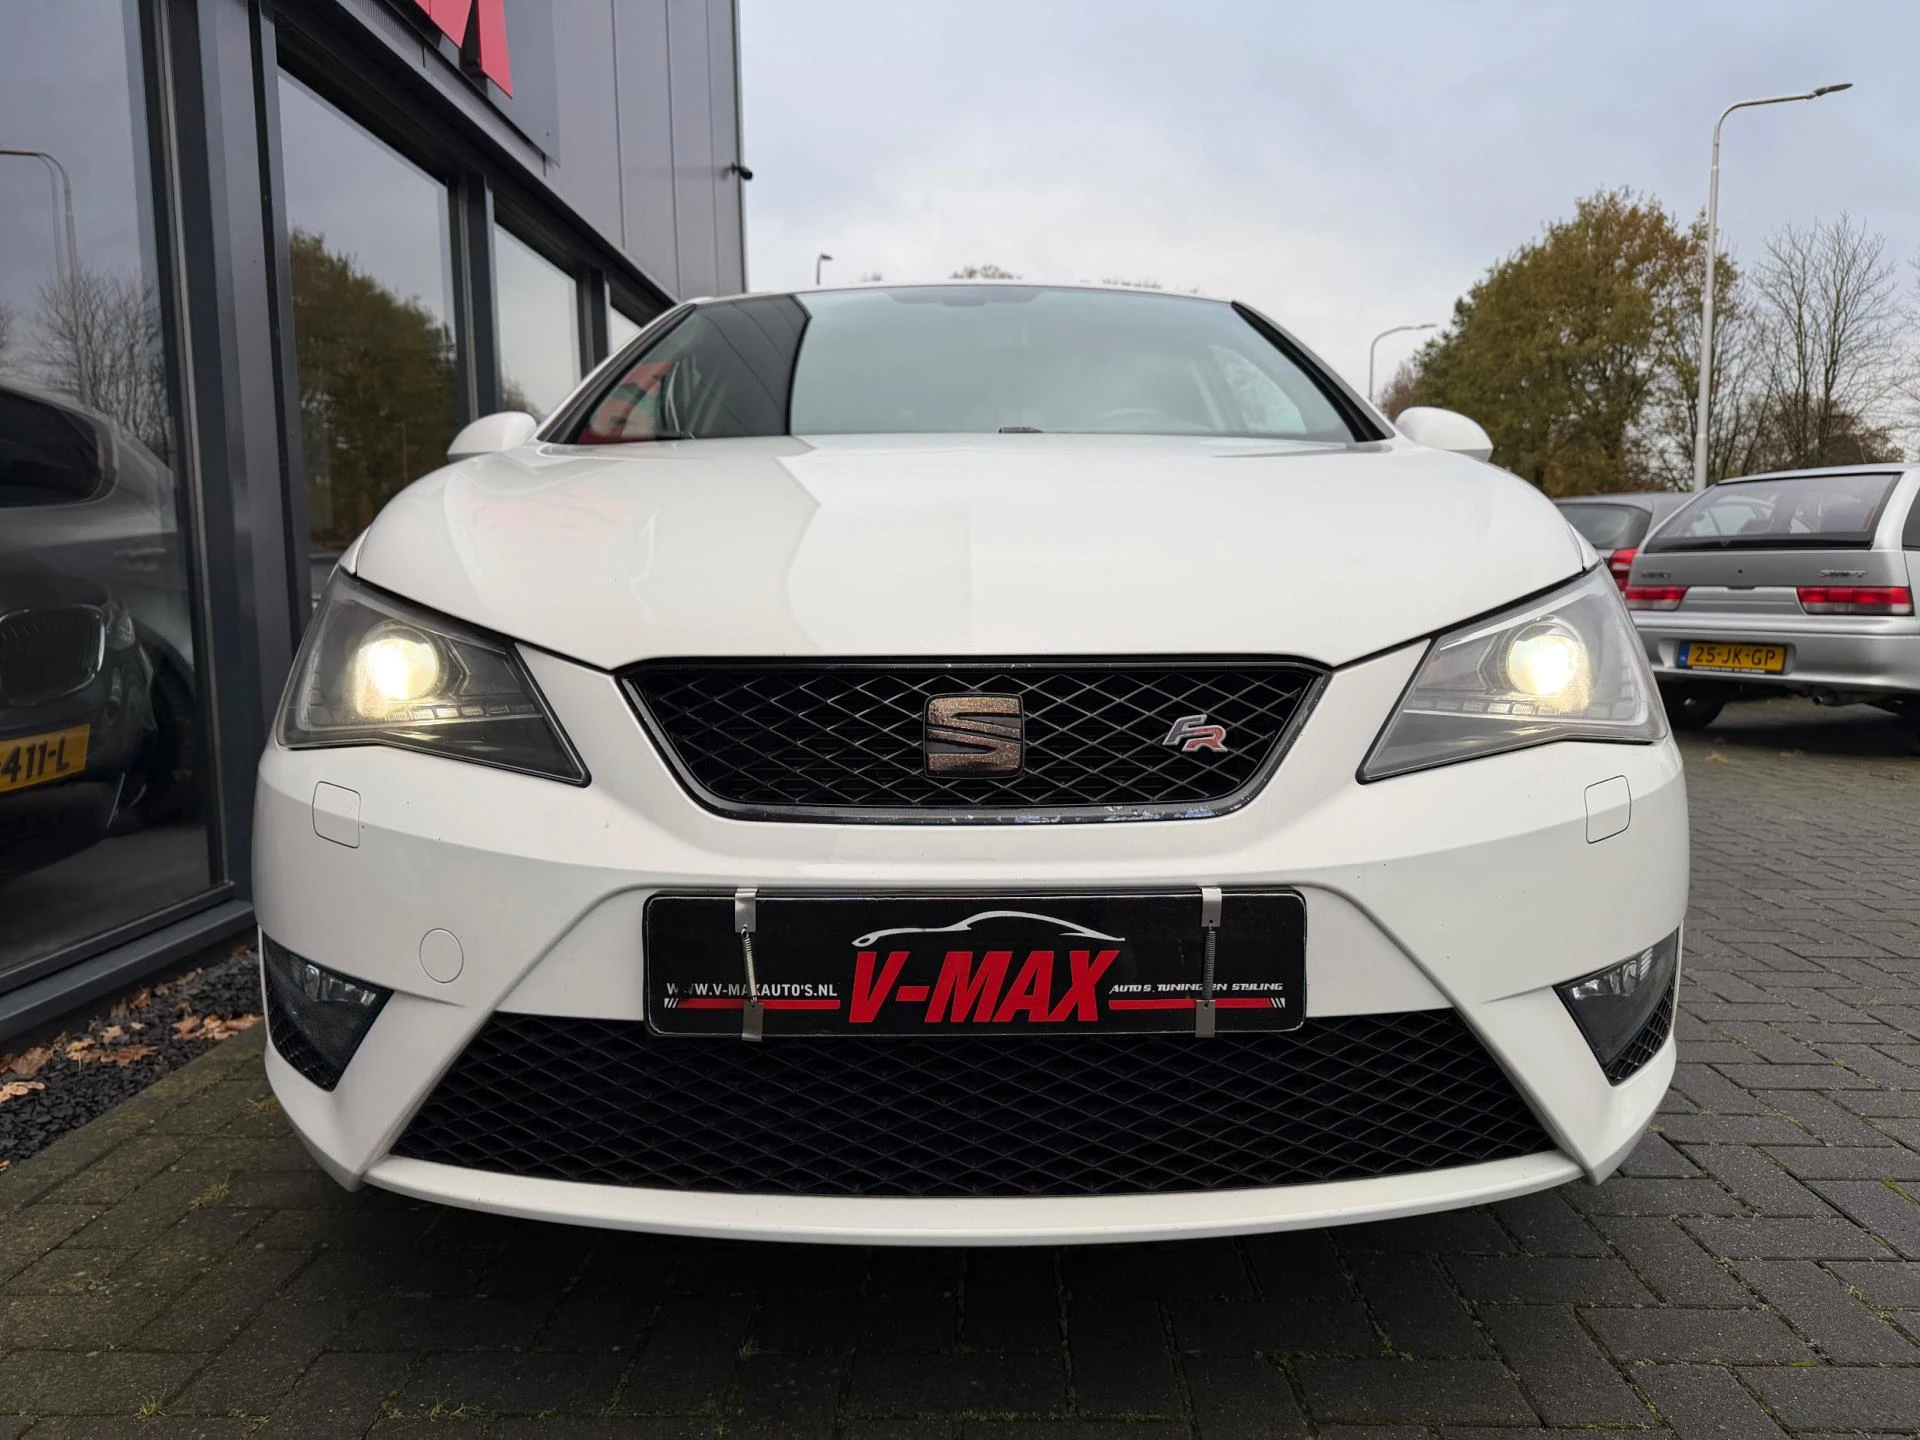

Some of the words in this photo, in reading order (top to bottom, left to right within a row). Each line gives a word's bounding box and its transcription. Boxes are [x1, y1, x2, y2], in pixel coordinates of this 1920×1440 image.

[1694, 646, 1776, 667] 25-JK-GP
[1161, 713, 1229, 752] FR
[0, 736, 71, 784] 411-L
[666, 982, 838, 997] WW.V-MAAUTO'S.NL
[849, 950, 1121, 1023] V-MAX
[1156, 983, 1204, 993] TUNING
[1231, 982, 1284, 991] STYLING
